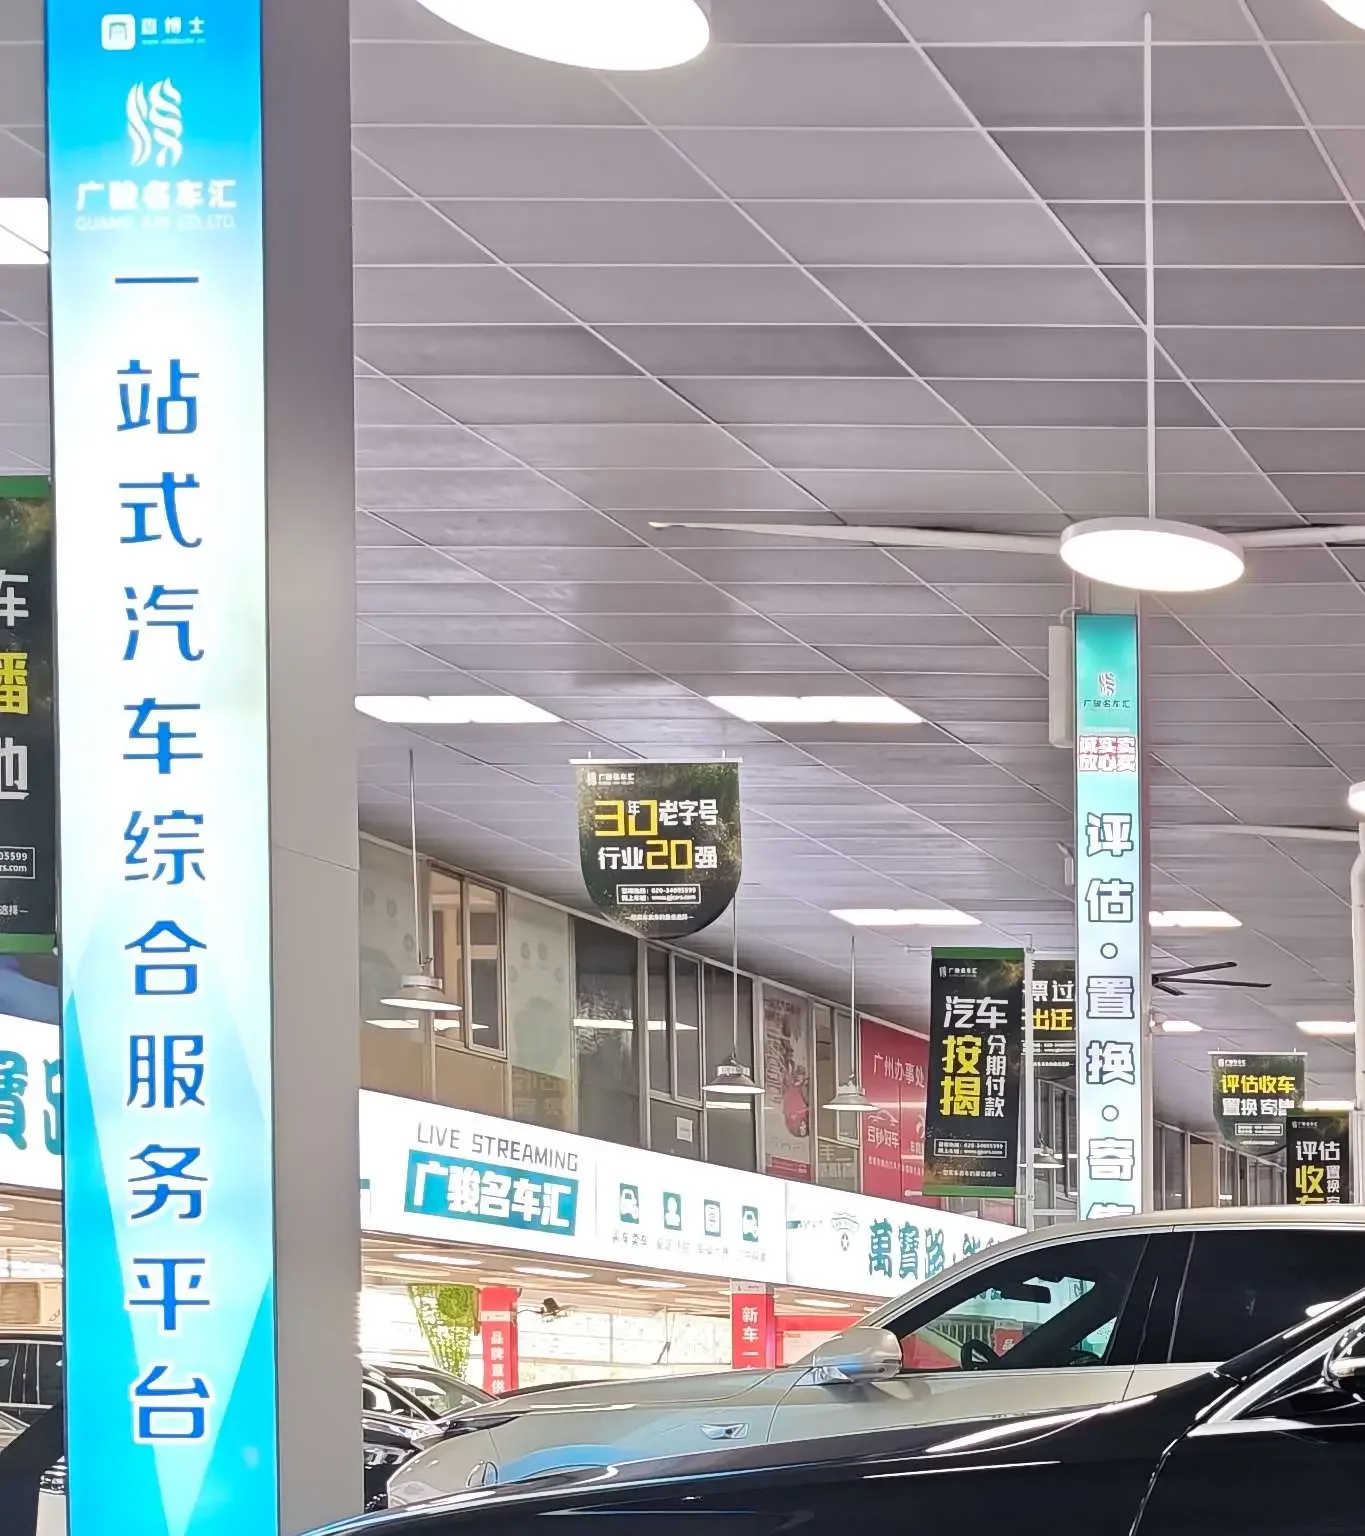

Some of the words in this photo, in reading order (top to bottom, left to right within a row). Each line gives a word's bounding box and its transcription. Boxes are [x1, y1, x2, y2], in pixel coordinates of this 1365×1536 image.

[114, 276, 210, 1440] 一站式汽车综合服务平台
[598, 839, 718, 870] 行业20强
[943, 995, 1009, 1029] 汽车
[940, 1034, 982, 1118] 按揭
[984, 1033, 1007, 1118] 分期付款
[1220, 1075, 1296, 1093] 评估收车
[417, 1121, 461, 1150] LIVE
[471, 1133, 578, 1172] STREAMING
[1296, 1141, 1340, 1161] 评估
[413, 1160, 572, 1229] 广骏名车汇
[741, 1306, 760, 1371] 新车一
